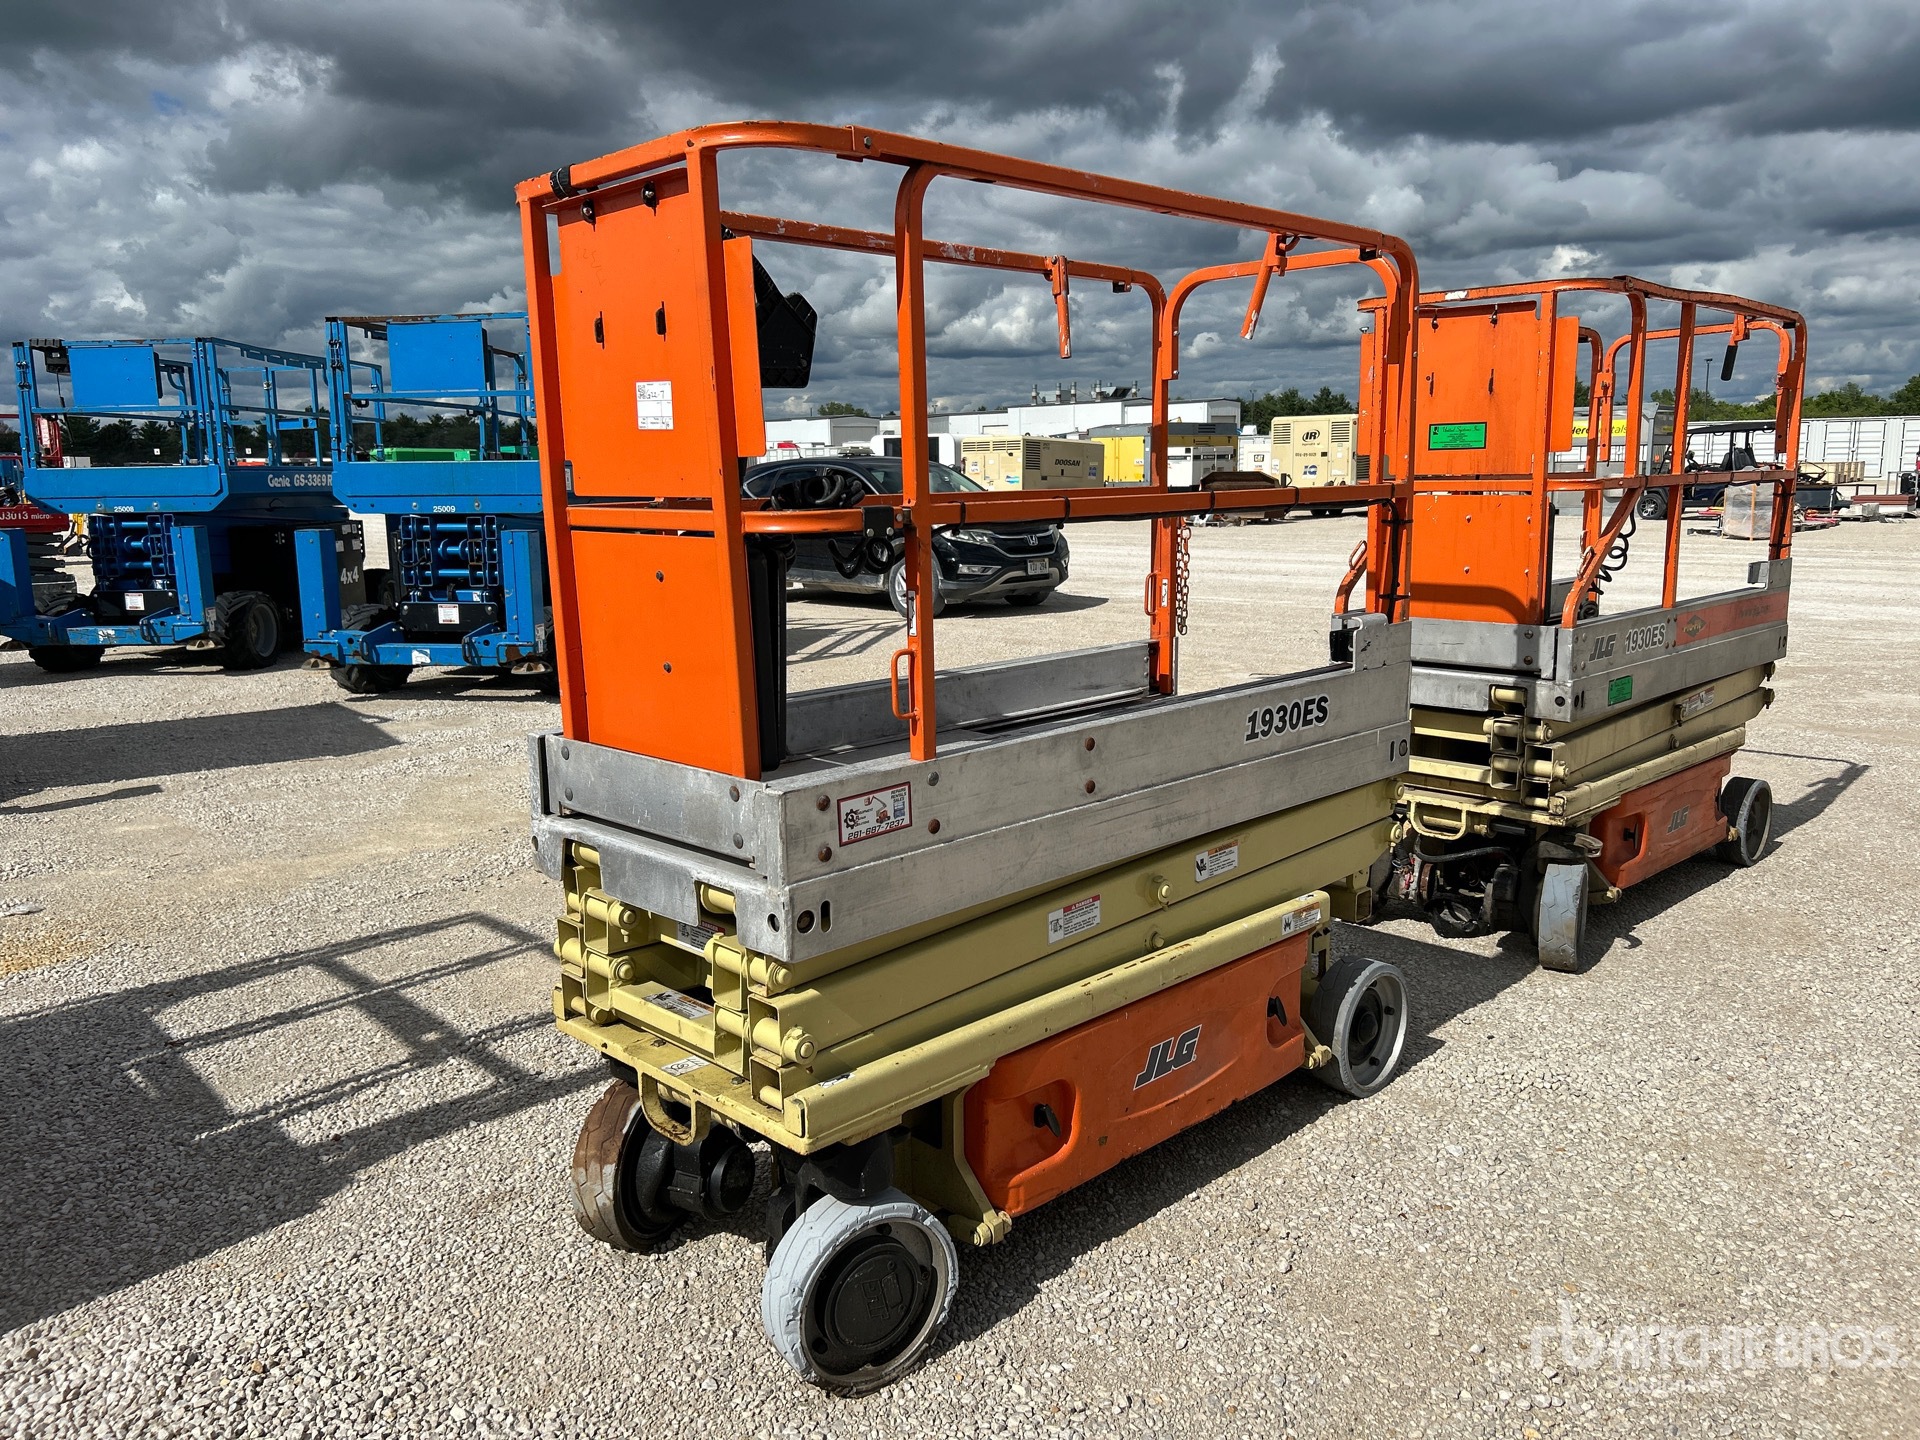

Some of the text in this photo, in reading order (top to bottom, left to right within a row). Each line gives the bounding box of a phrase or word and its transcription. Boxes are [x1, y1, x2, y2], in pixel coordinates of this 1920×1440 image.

[1054, 459, 1081, 467] DOOSAN
[267, 474, 291, 488] Genie
[293, 474, 327, 487] GS-3369
[432, 505, 456, 513] 25009
[340, 565, 360, 585] 4x4
[1588, 632, 1617, 663] JLG
[1625, 623, 1666, 654] 1930ES
[1244, 694, 1330, 743] 1930ES
[1666, 805, 1690, 835] JLG
[1133, 1024, 1202, 1091] JLG
